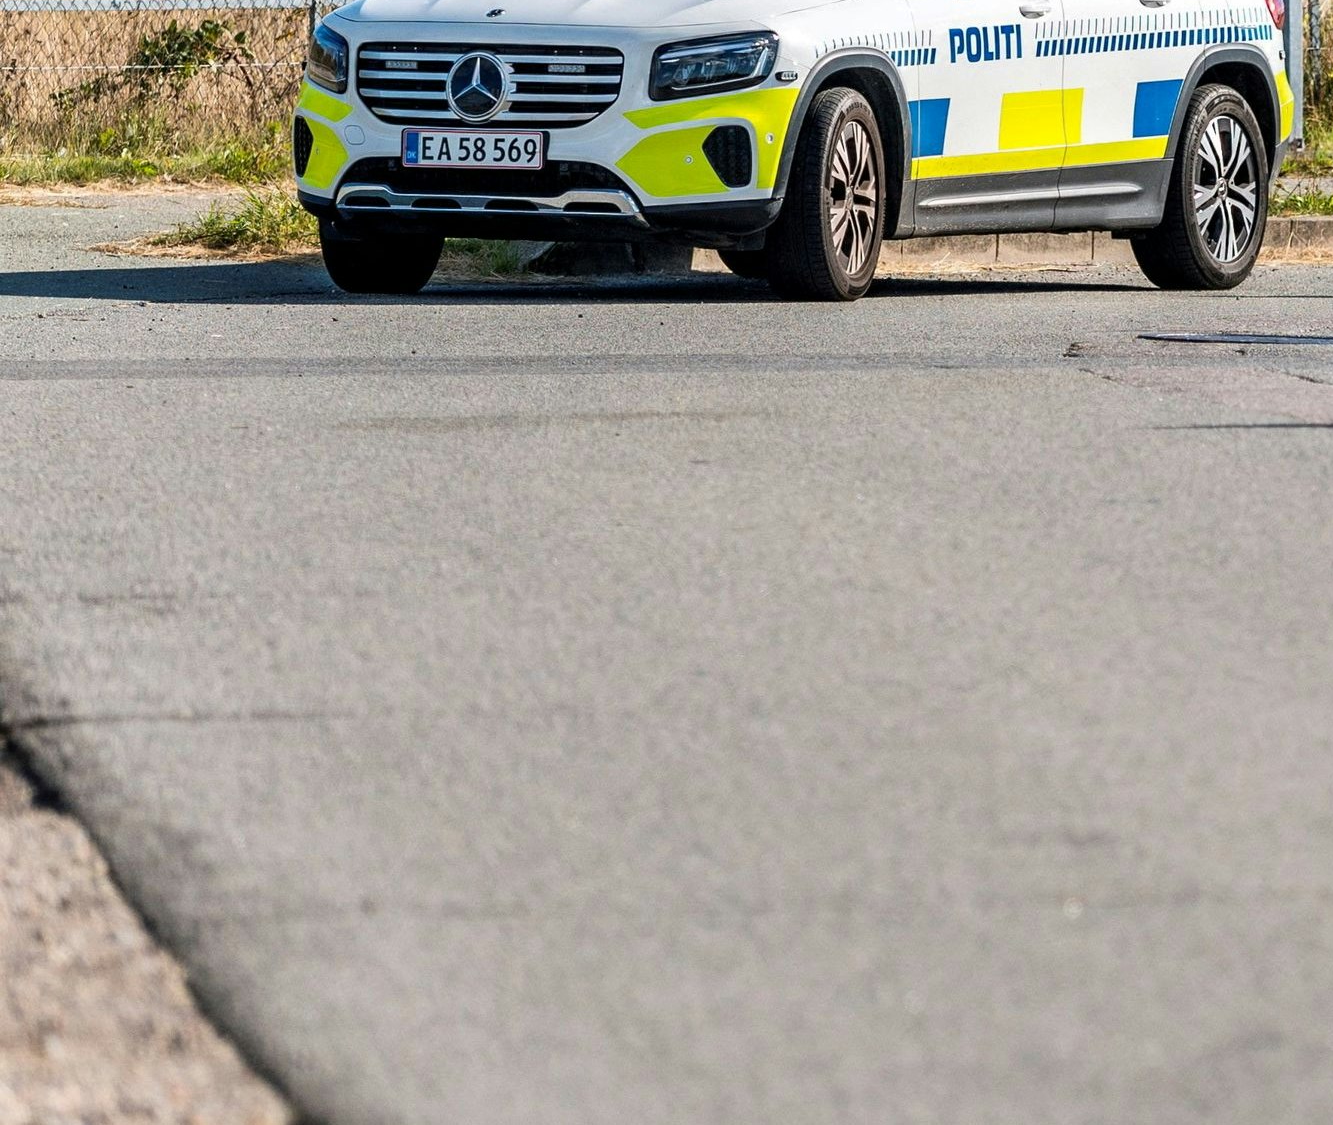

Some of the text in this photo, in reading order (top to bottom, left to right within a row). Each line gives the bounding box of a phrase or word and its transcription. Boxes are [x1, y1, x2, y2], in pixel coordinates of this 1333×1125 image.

[948, 23, 1022, 64] POLITI
[406, 136, 538, 164] DK EA 58 569
